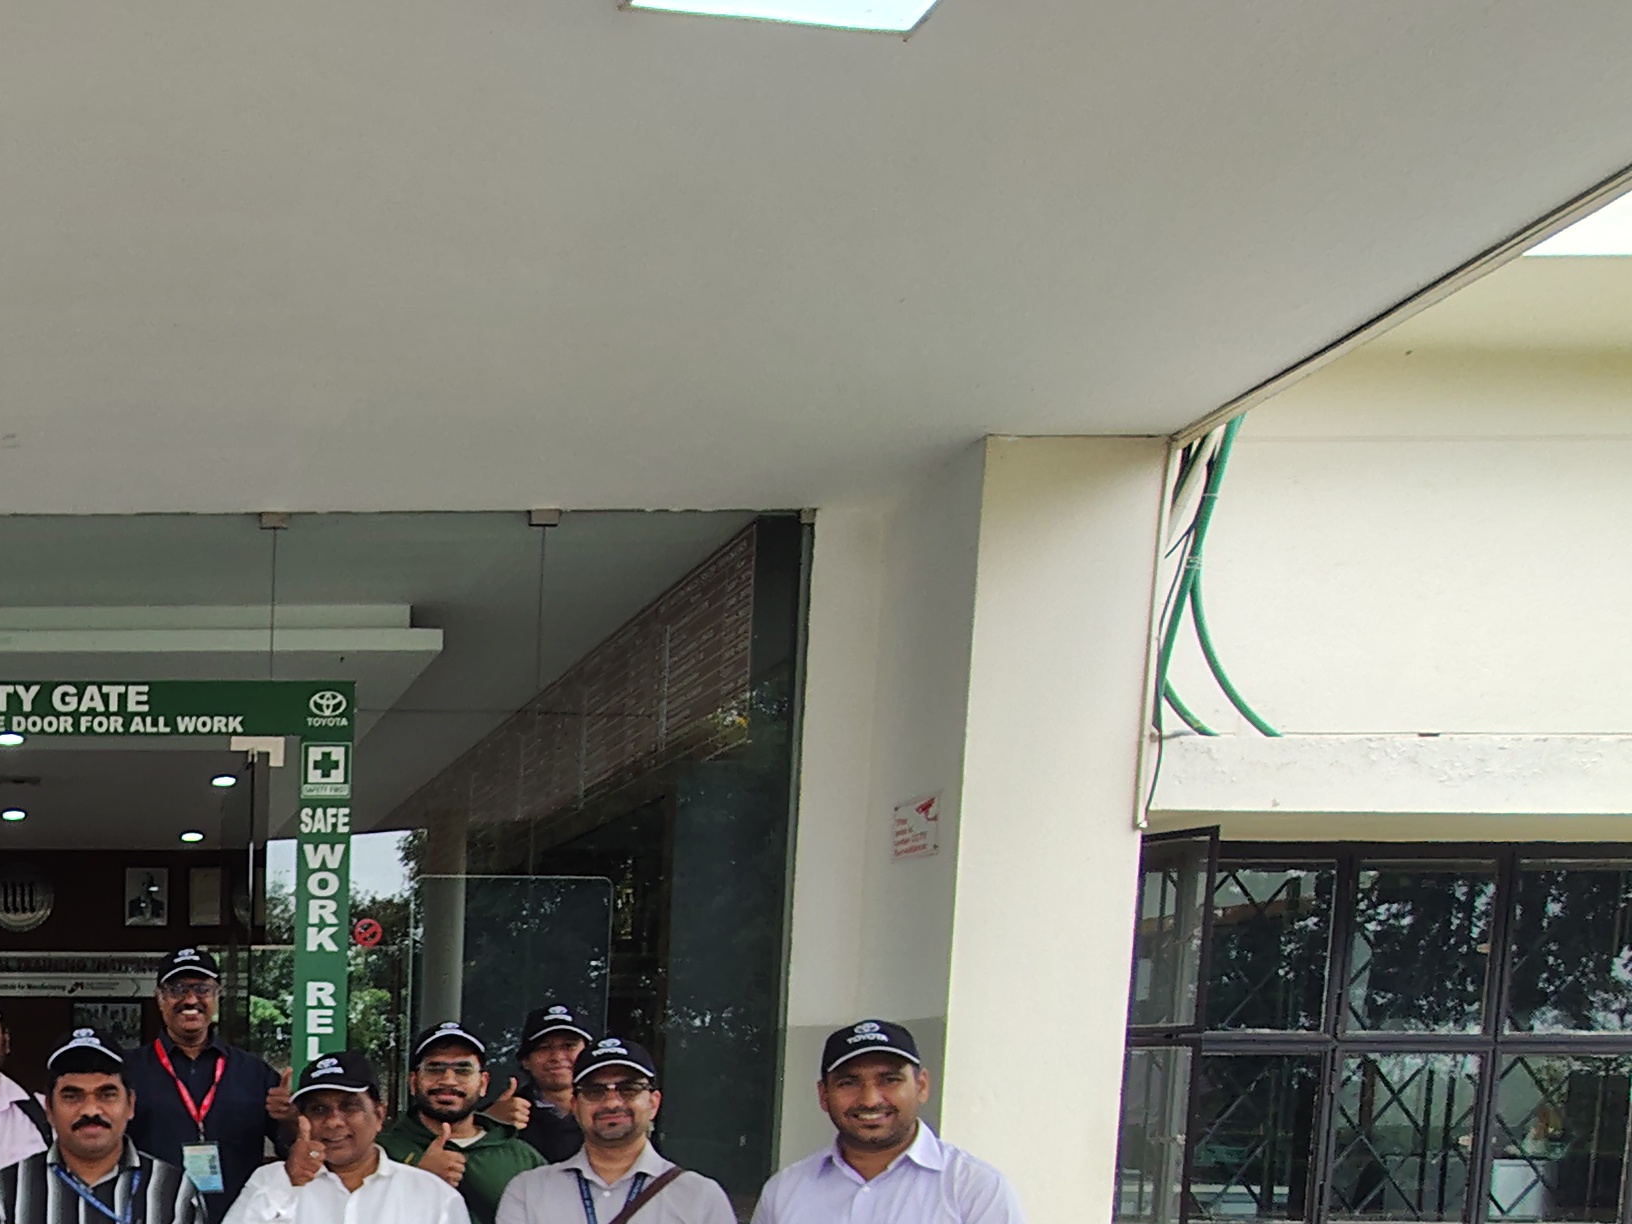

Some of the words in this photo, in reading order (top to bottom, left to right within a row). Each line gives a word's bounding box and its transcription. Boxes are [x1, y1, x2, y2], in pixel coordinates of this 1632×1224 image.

[52, 684, 150, 713] GATE
[11, 715, 74, 733] DOOR
[79, 715, 124, 733] FOR
[129, 715, 172, 733] ALL
[175, 715, 244, 733] WORK
[306, 717, 349, 727] TOYOTA
[300, 807, 351, 833] SAFE
[303, 843, 346, 952] WORK
[305, 980, 337, 1061] REL
[847, 1032, 889, 1044] TOYOTA
